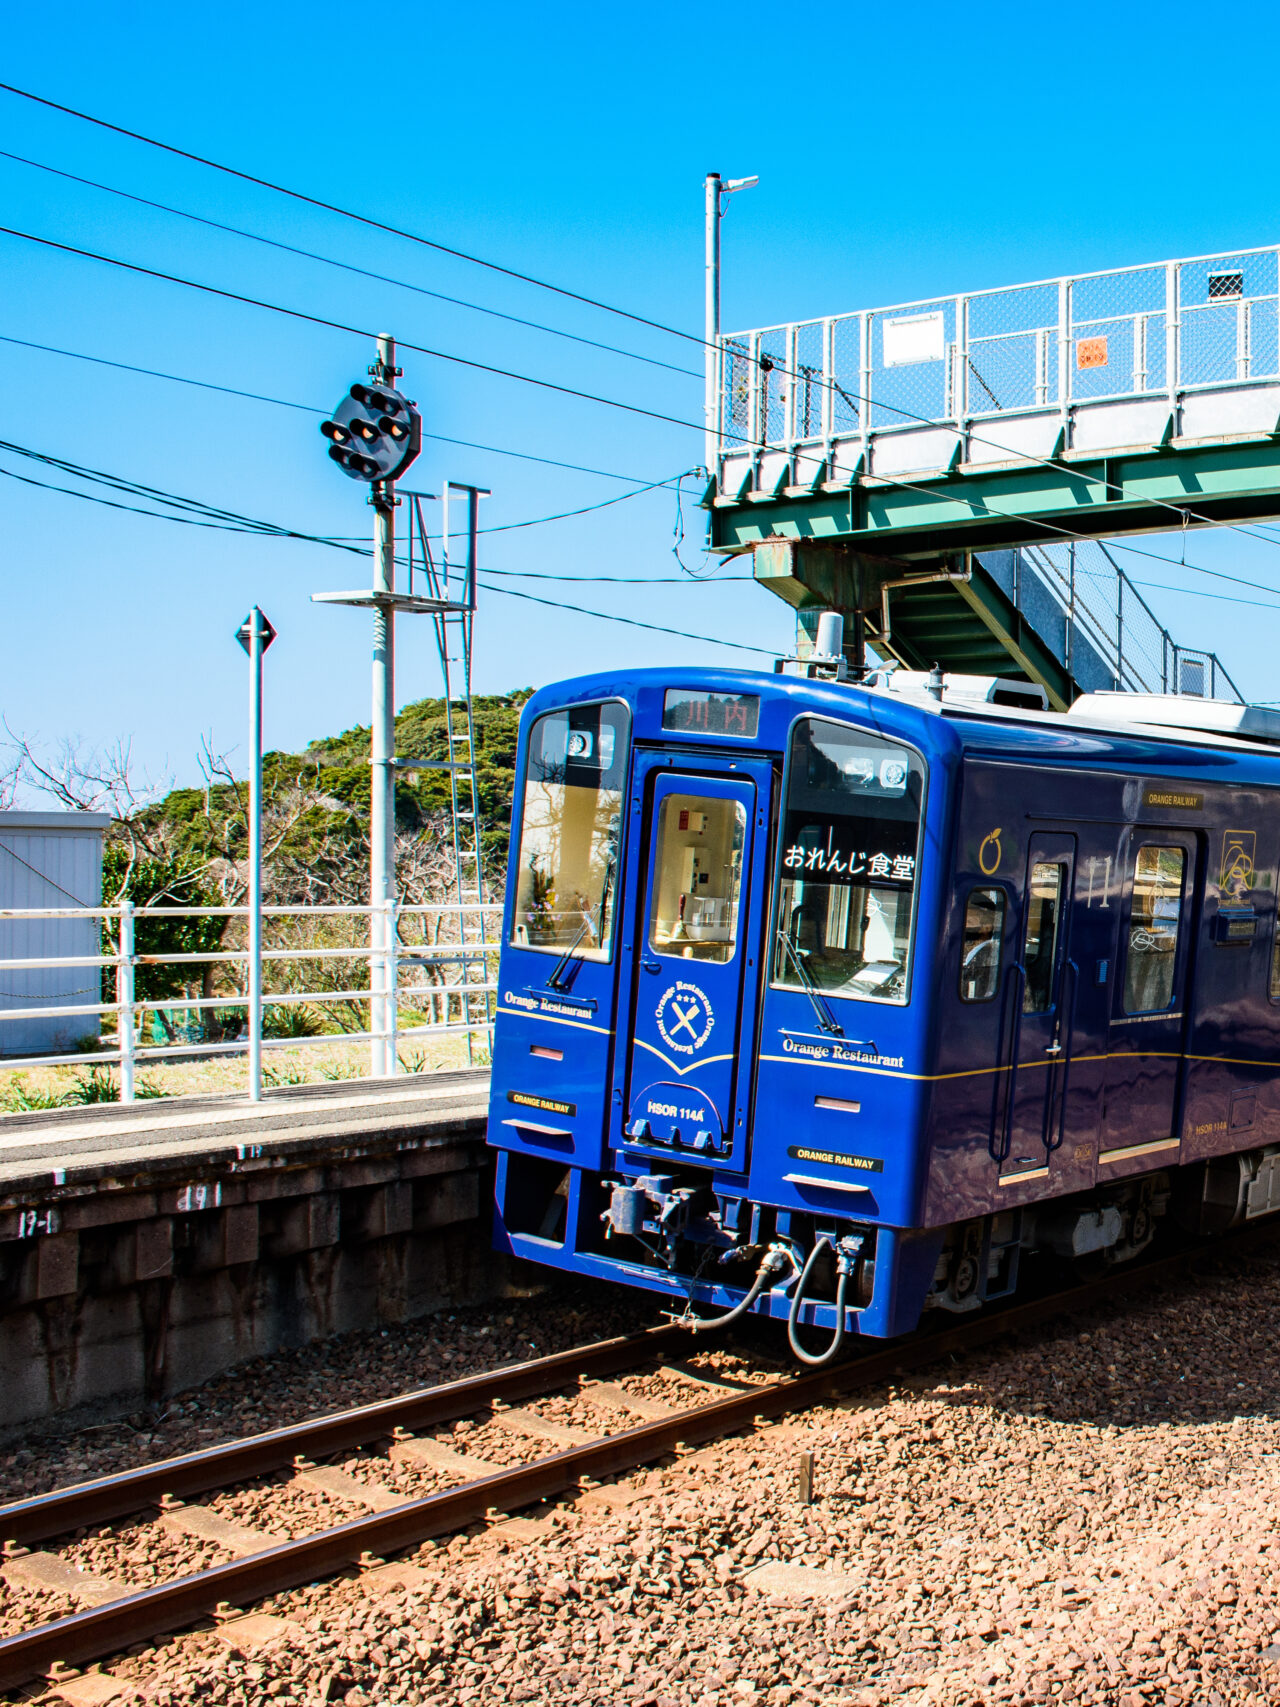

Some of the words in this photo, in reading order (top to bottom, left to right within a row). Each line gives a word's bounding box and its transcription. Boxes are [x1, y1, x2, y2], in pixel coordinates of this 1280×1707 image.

[685, 700, 748, 731] 川内
[1148, 793, 1173, 805] ORANGE
[1172, 797, 1198, 807] RAILWAY
[784, 844, 916, 881] おれんじ食堂
[504, 990, 540, 1010] Orange
[540, 997, 593, 1019] Restaurant
[655, 986, 676, 1018] Orange
[676, 980, 714, 1017] Restaurant
[782, 1038, 830, 1059] Orange
[832, 1045, 905, 1069] Restaurant
[513, 1094, 541, 1109] ORANGE
[540, 1099, 570, 1114] RAILWAY
[647, 1100, 678, 1117] HSOR
[679, 1107, 705, 1122] 114A
[1195, 1123, 1213, 1136] HSOR
[797, 1149, 834, 1163] ORANGE
[834, 1154, 874, 1169] RAILWAY
